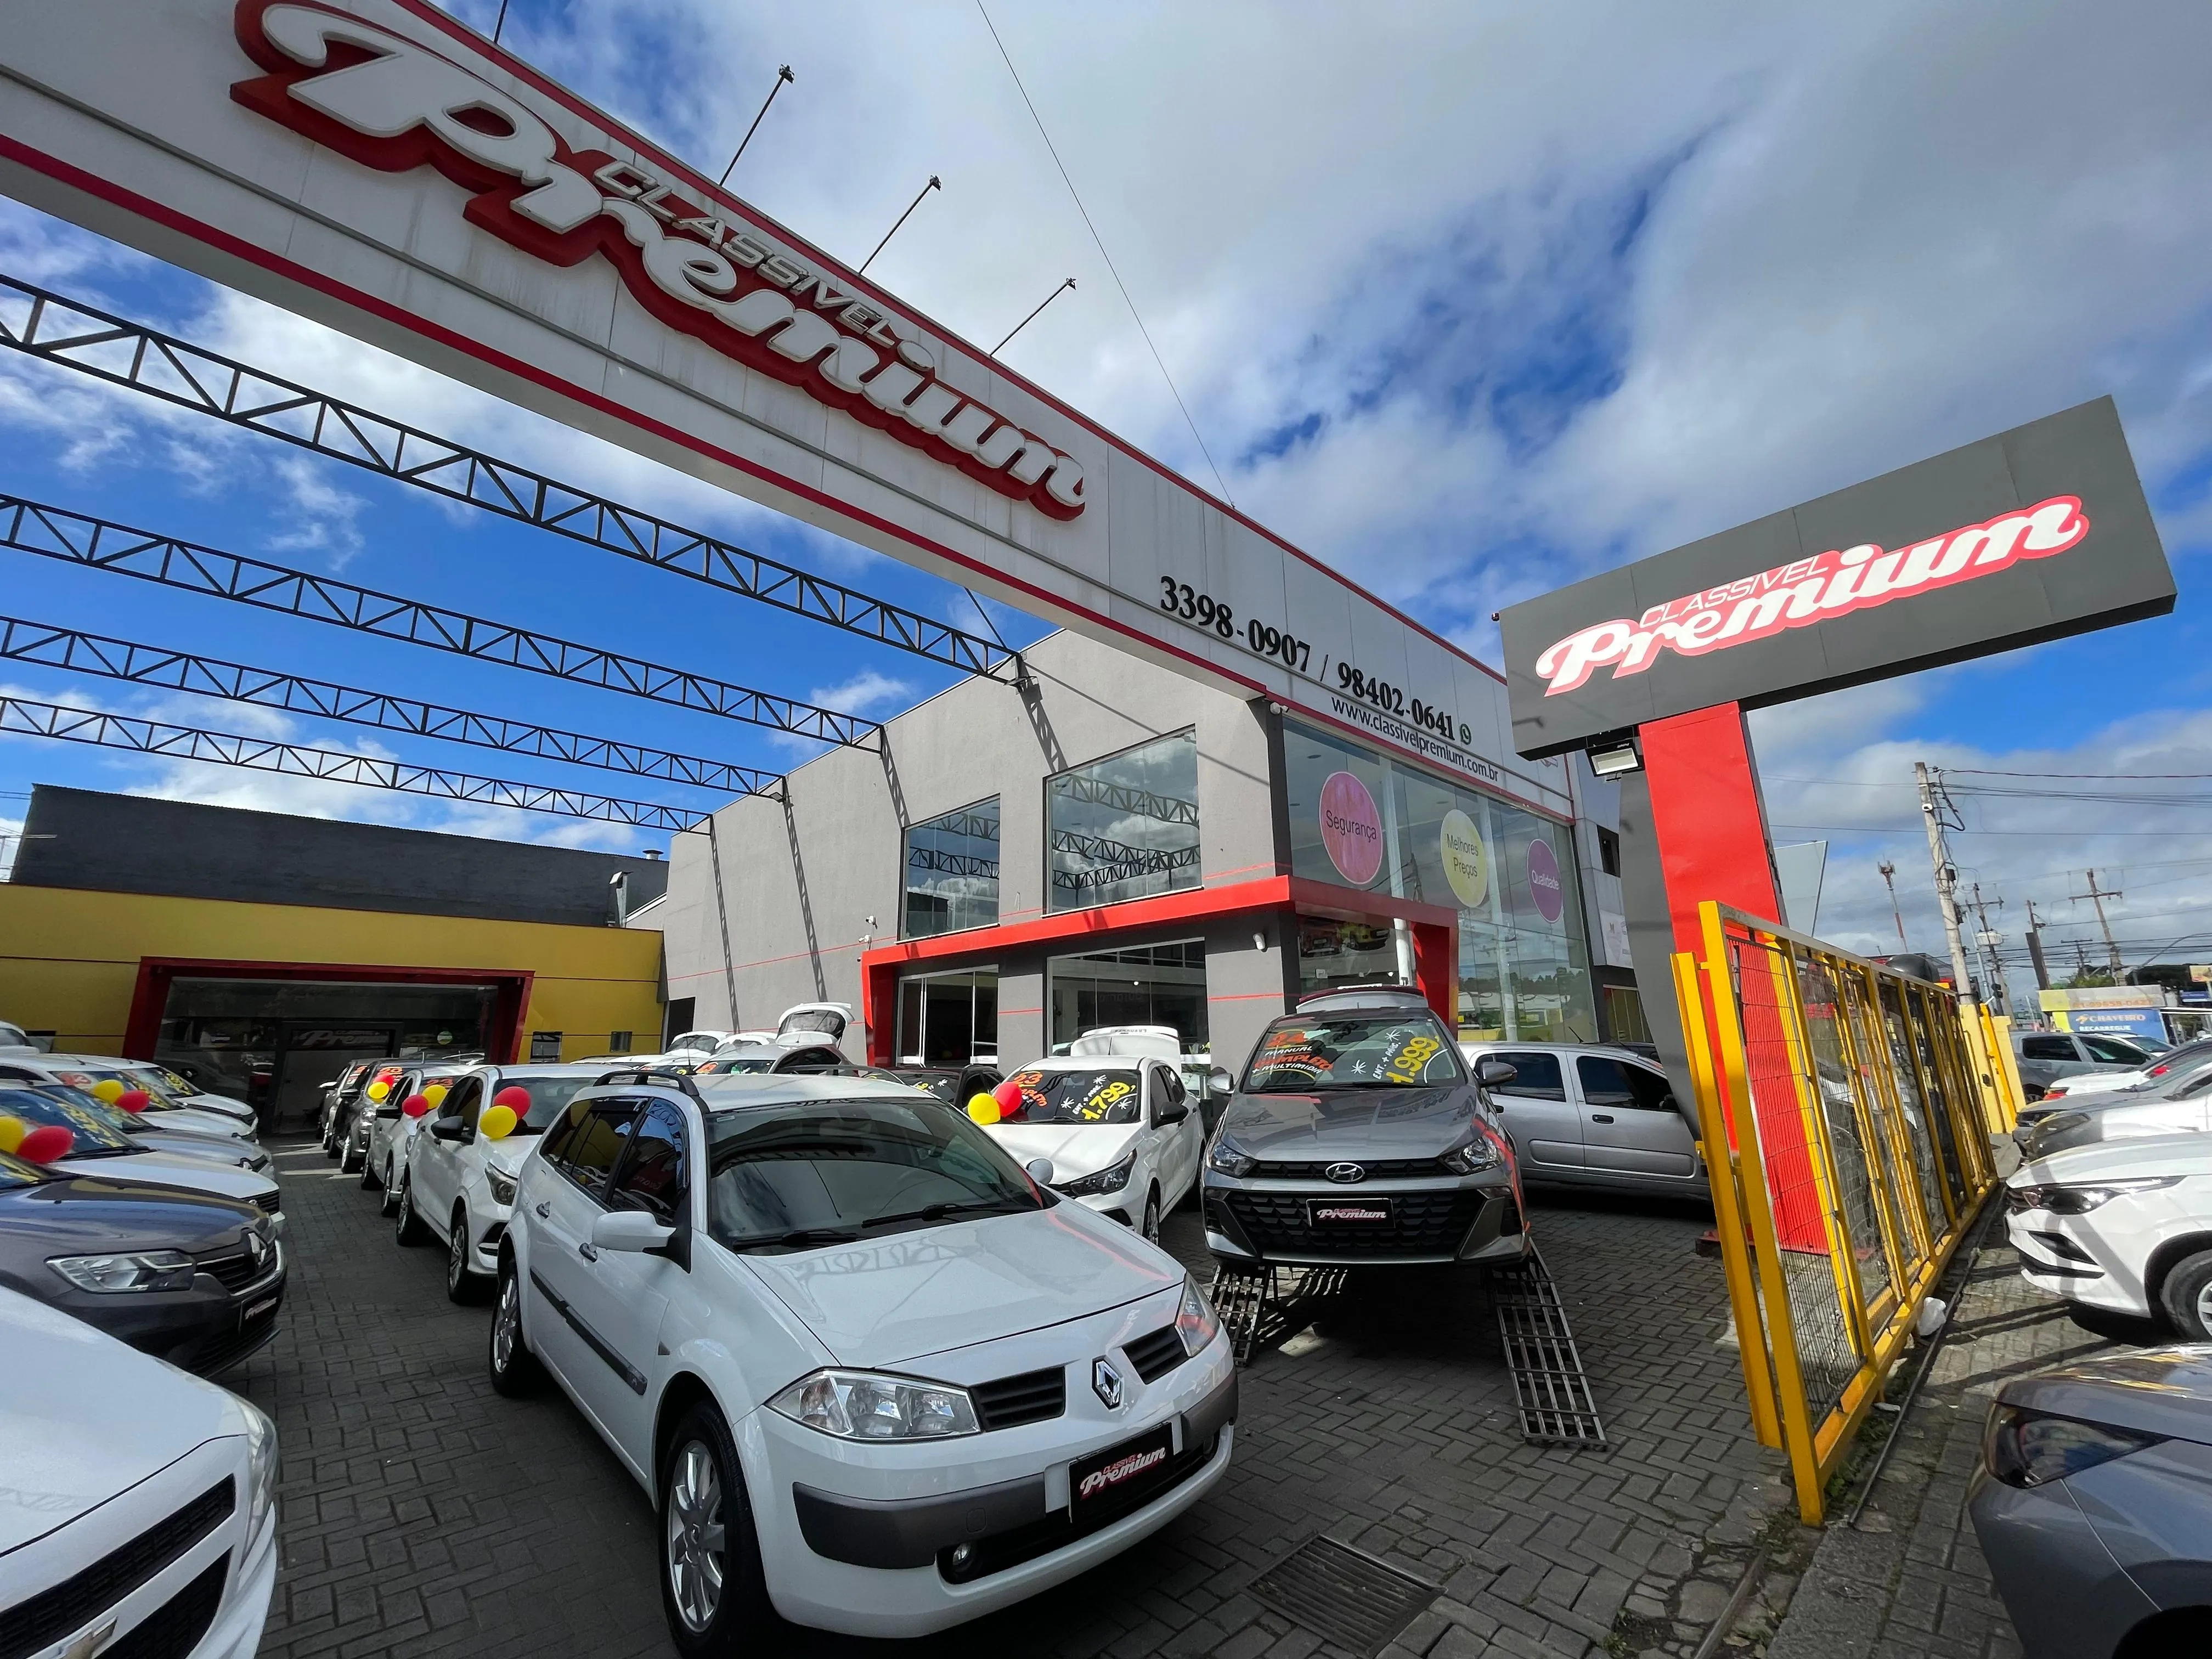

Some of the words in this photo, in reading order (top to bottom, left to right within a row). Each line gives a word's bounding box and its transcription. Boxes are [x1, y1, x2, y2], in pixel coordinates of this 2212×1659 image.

[261, 2, 1085, 507] Premium
[592, 160, 895, 347] CLASSIVEL
[1536, 503, 2081, 689] Premium
[1639, 554, 1829, 629] CLASSIVEL
[1160, 575, 1311, 673] 3398-0907
[1319, 653, 1329, 682] /
[1338, 662, 1455, 741] 98402-0641
[1331, 697, 1499, 782] www.classivelpremium.com.br
[1325, 809, 1377, 843] Segurança
[1446, 833, 1480, 856] Melhores
[1453, 857, 1478, 879] Preços
[1531, 870, 1559, 890] Qualidade
[1265, 1046, 1313, 1057] MANUAL
[1317, 1209, 1386, 1219] Premium
[1080, 1447, 1166, 1495] Premium
